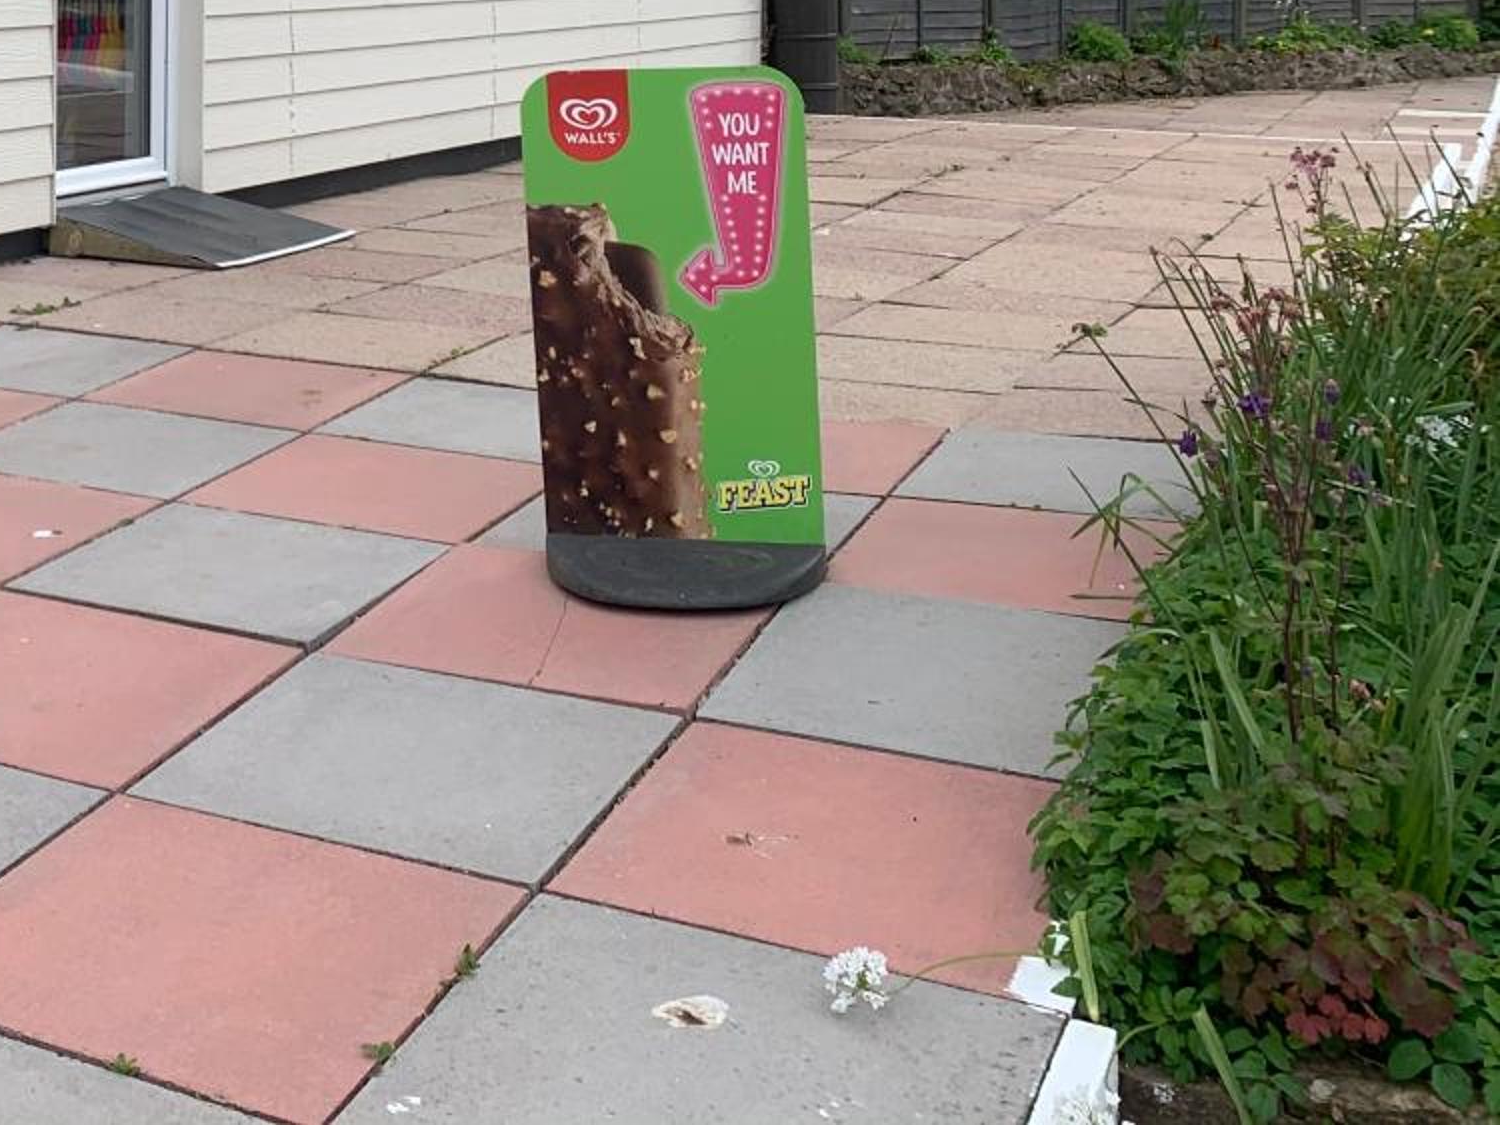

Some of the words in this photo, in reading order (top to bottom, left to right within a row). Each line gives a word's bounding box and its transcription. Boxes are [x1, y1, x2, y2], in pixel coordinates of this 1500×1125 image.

[718, 113, 760, 137] YOU
[564, 132, 618, 145] WALL'S
[711, 142, 770, 166] WANT
[727, 171, 758, 195] ME
[718, 475, 811, 512] FEAST
